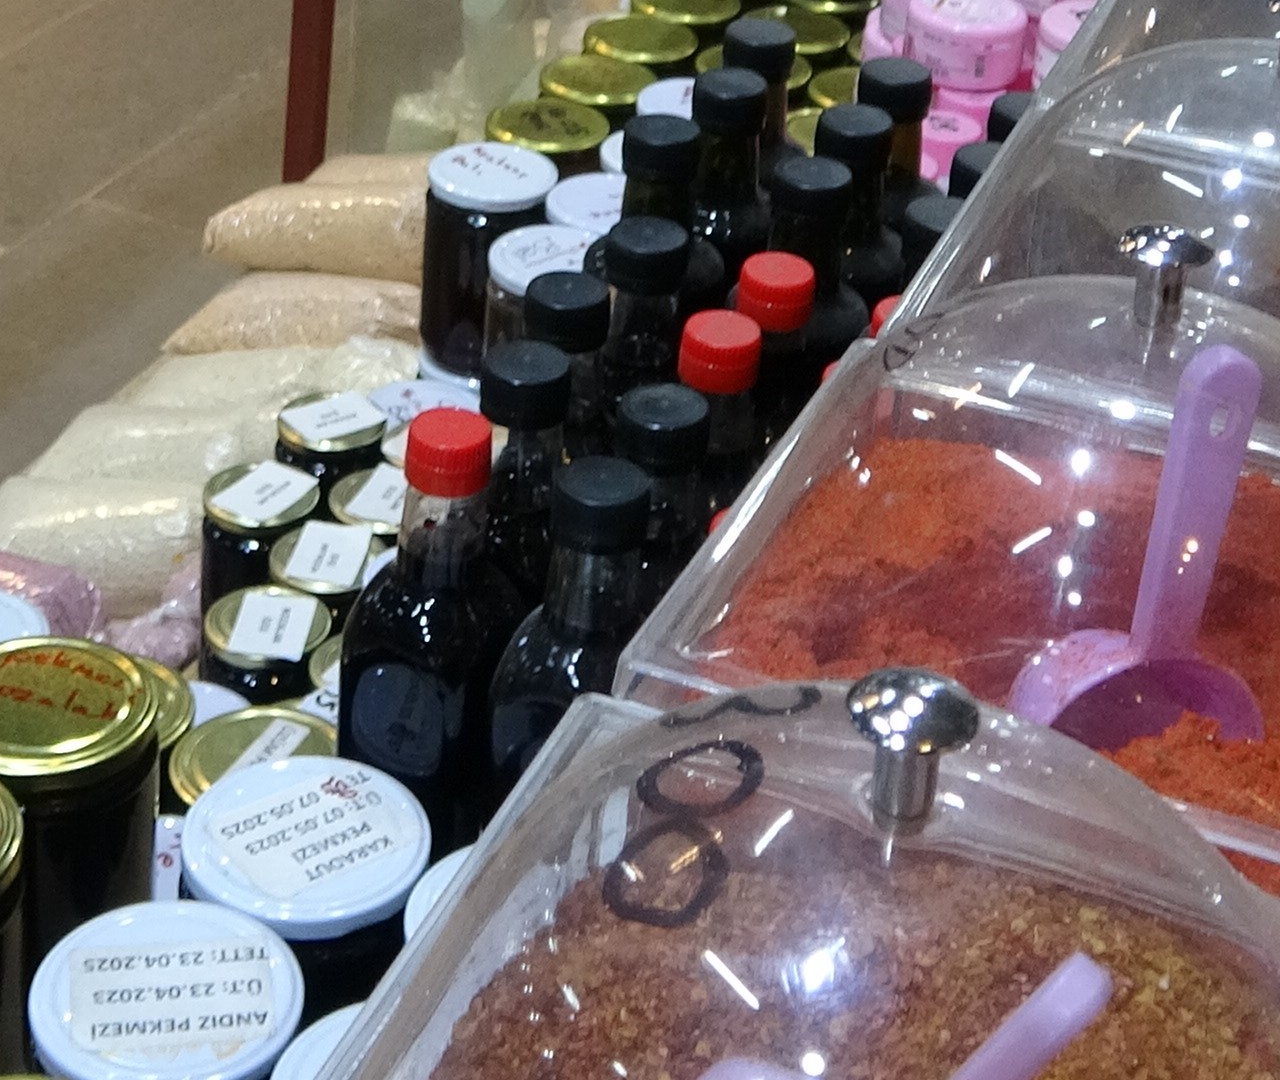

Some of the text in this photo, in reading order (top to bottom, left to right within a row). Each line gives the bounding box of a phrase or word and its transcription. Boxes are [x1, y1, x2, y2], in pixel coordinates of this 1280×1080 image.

[304, 833, 393, 883] KARADUT
[83, 951, 203, 973] 23.04.2025
[92, 983, 213, 1004] 23.04.2023
[91, 1011, 267, 1038] ANDIZ PEKMEZİ
